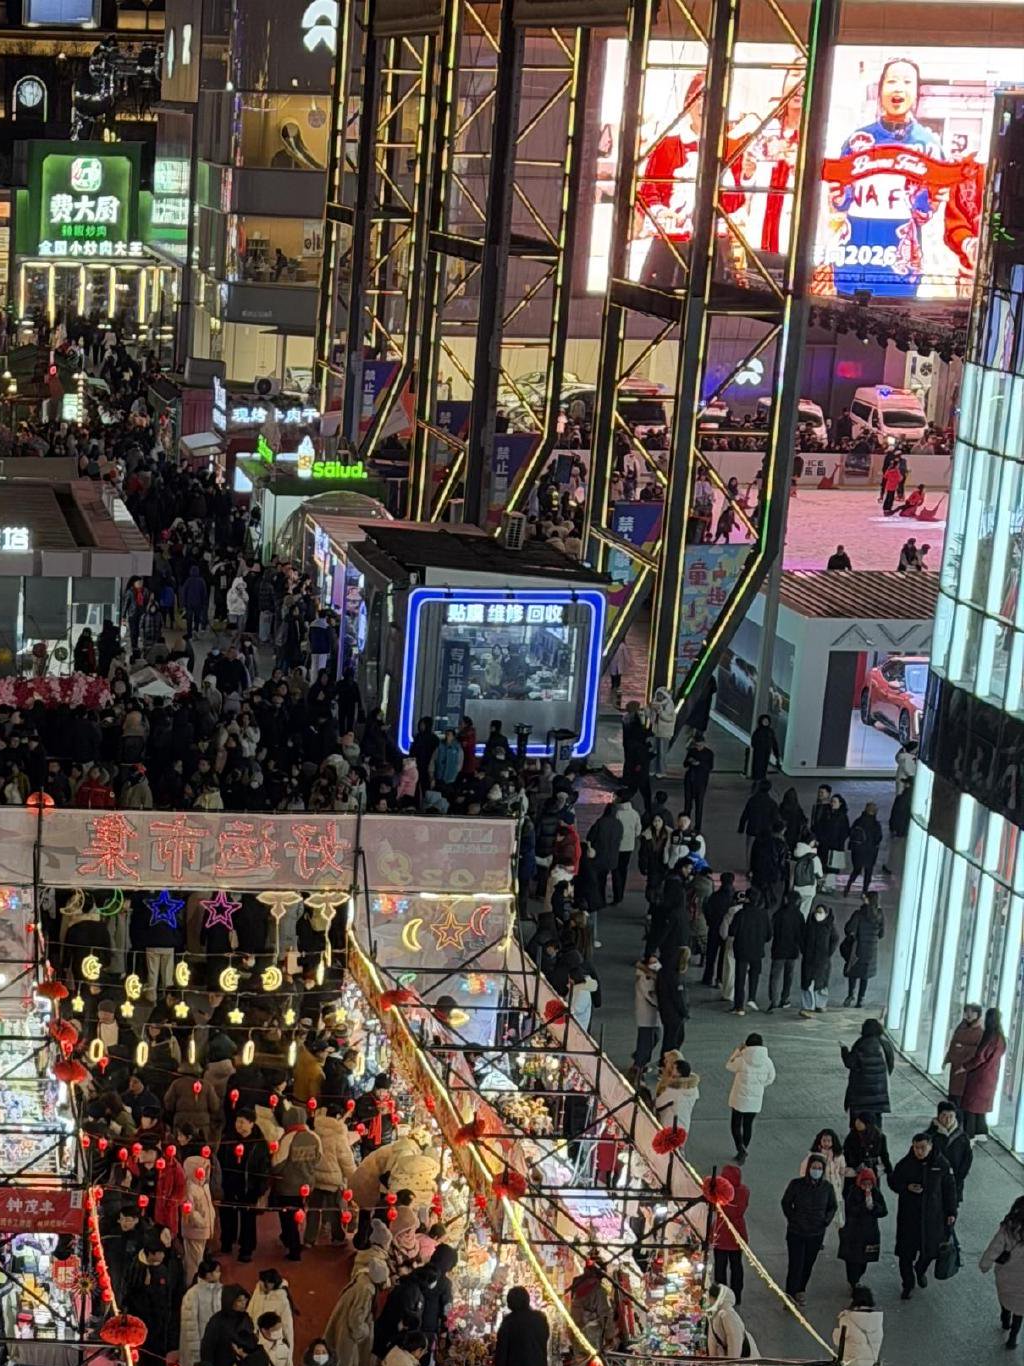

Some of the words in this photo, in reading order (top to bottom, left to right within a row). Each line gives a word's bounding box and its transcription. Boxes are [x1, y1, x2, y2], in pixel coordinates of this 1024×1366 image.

[50, 194, 121, 223] 费大厨
[38, 241, 144, 256] 全国小炒肉大王
[487, 604, 524, 622] 维修
[527, 604, 563, 622] 回收
